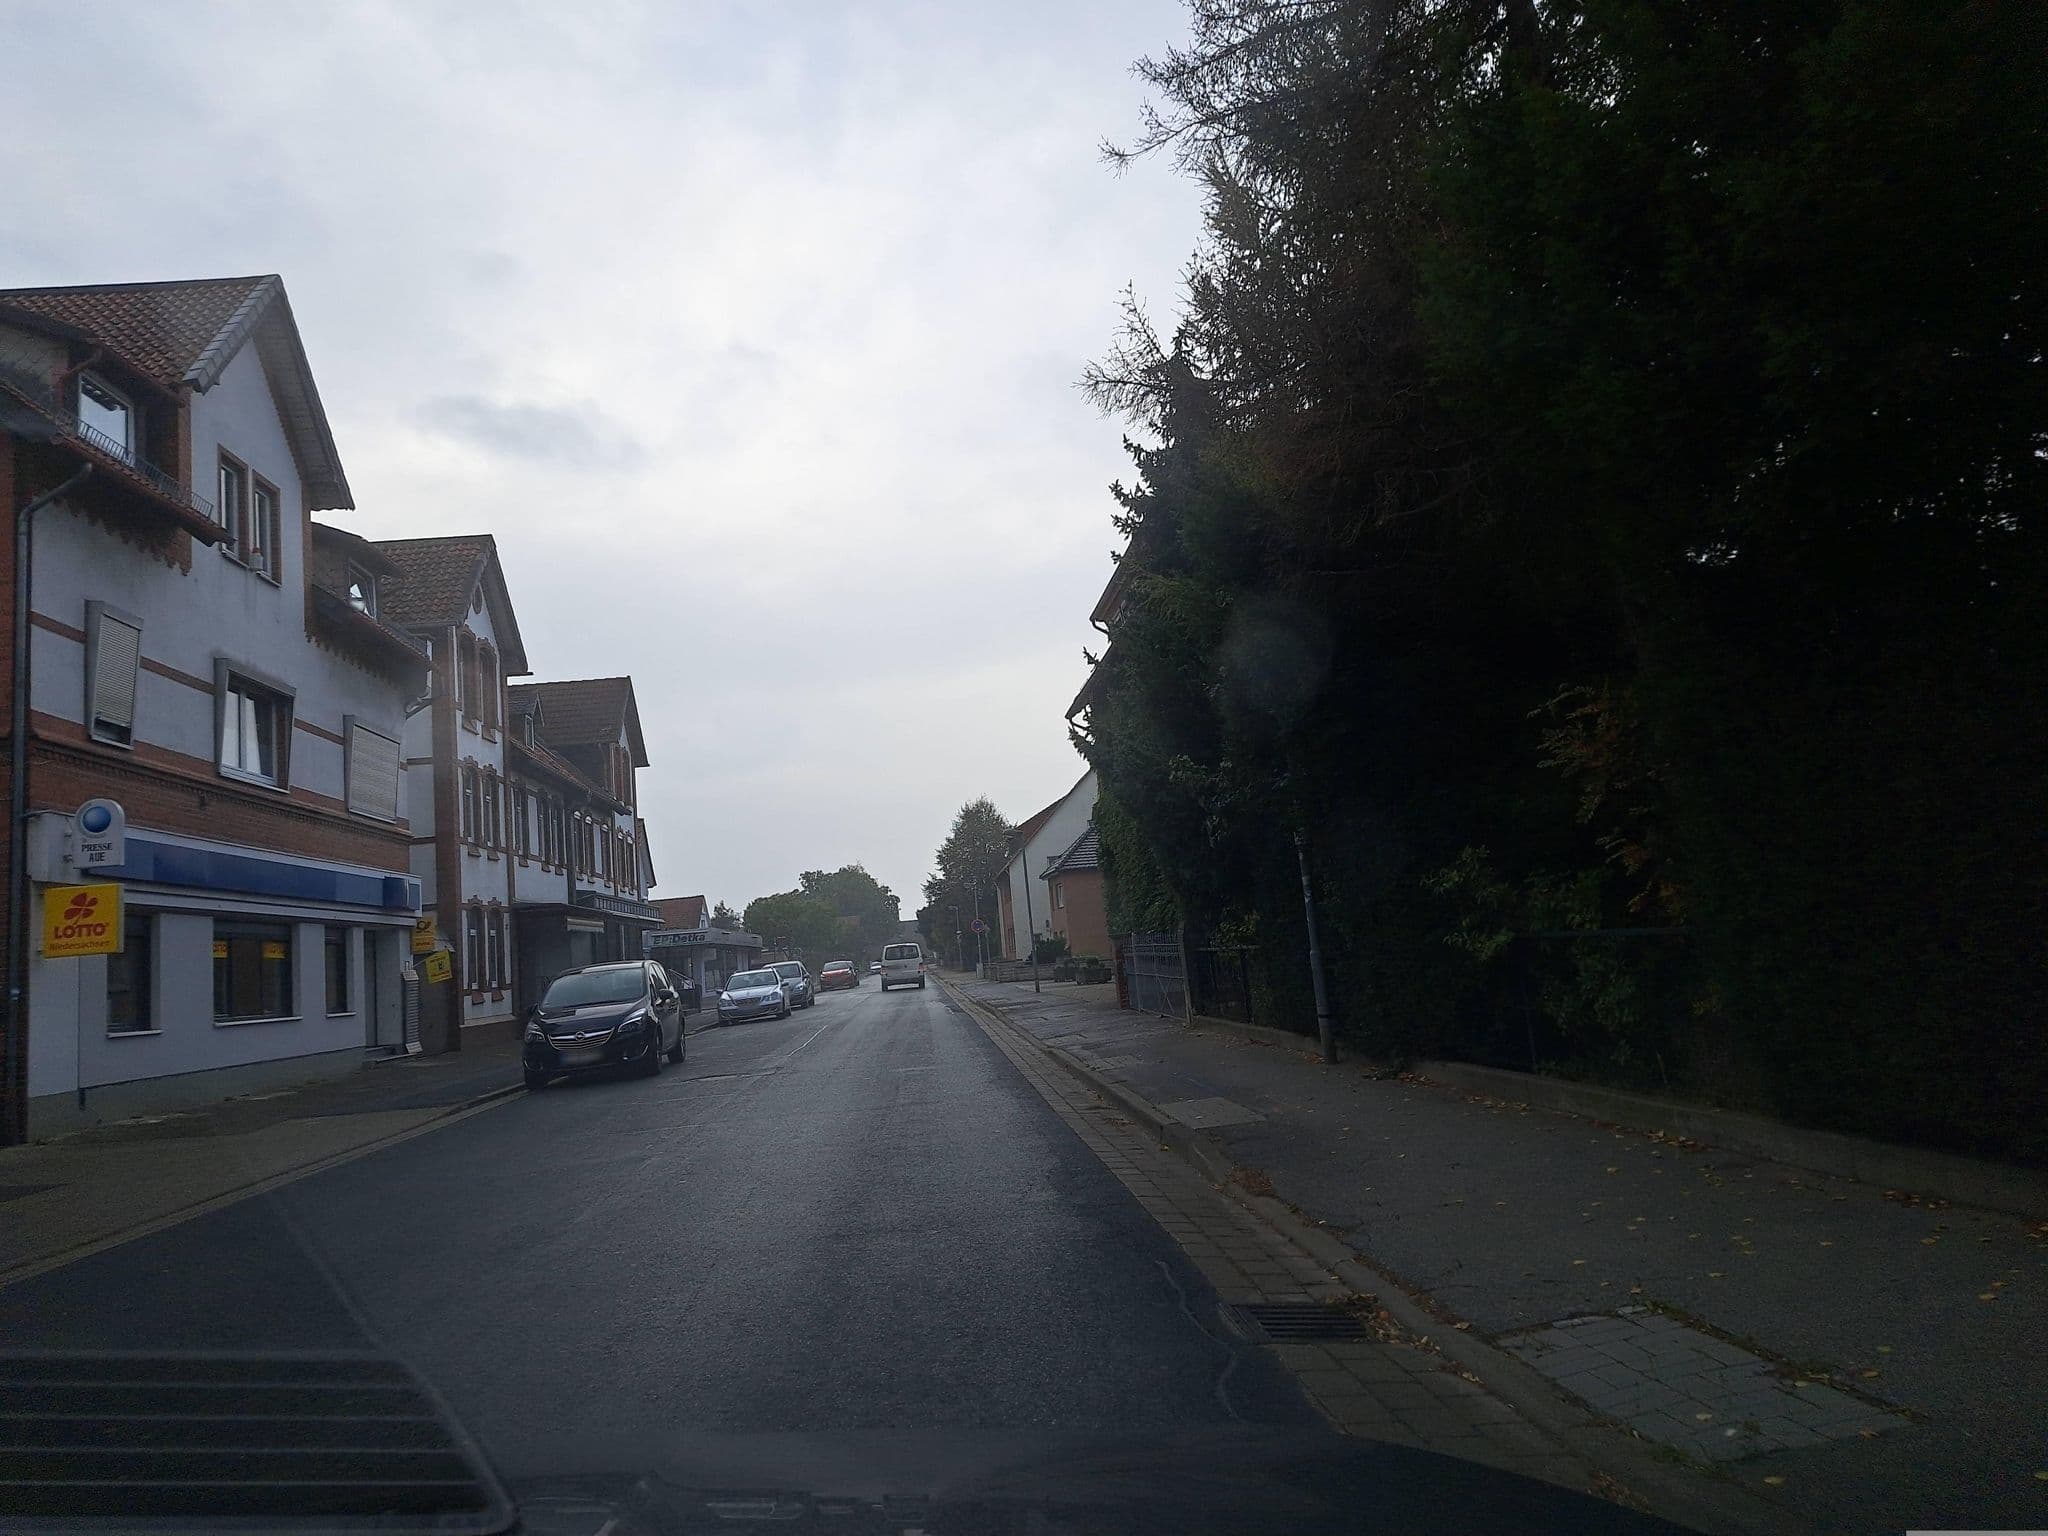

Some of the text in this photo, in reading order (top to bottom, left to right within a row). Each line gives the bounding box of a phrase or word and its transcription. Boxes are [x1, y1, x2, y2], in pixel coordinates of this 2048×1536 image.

[81, 843, 113, 852] PRESSE
[88, 852, 105, 862] AUE
[54, 923, 106, 939] LOTTO
